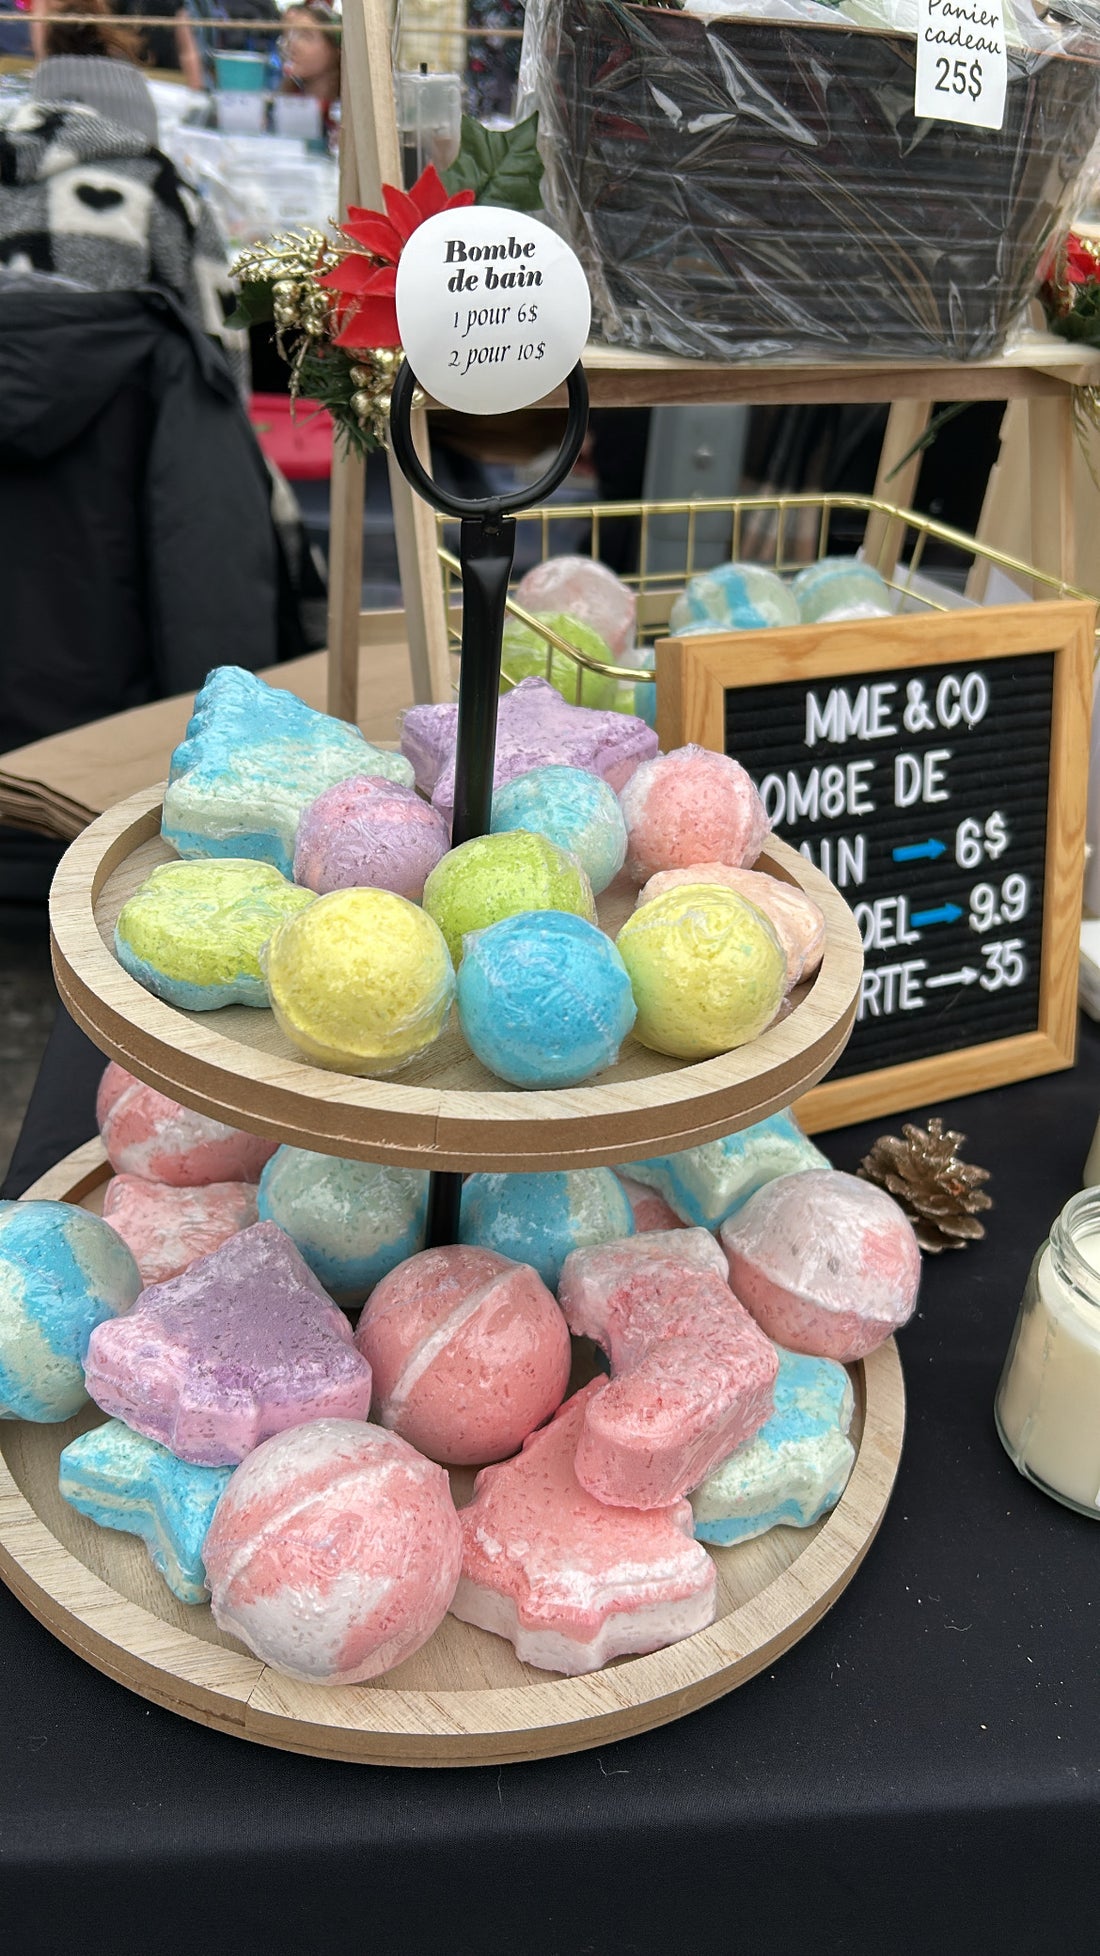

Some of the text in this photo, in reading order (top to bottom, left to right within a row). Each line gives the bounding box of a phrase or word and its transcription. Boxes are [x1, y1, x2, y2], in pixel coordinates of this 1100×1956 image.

[928, 0, 999, 27] Panier
[925, 26, 1001, 54] cadeau
[935, 57, 982, 102] 25$
[443, 237, 536, 263] Bombe
[448, 265, 543, 292] de bain
[454, 303, 538, 338] 1 pour 6$
[448, 341, 546, 375] 2 pour 10$
[894, 749, 951, 808] DE
[955, 810, 1008, 869] 6$
[968, 873, 1028, 933] 9.9
[979, 938, 1025, 992] 35
